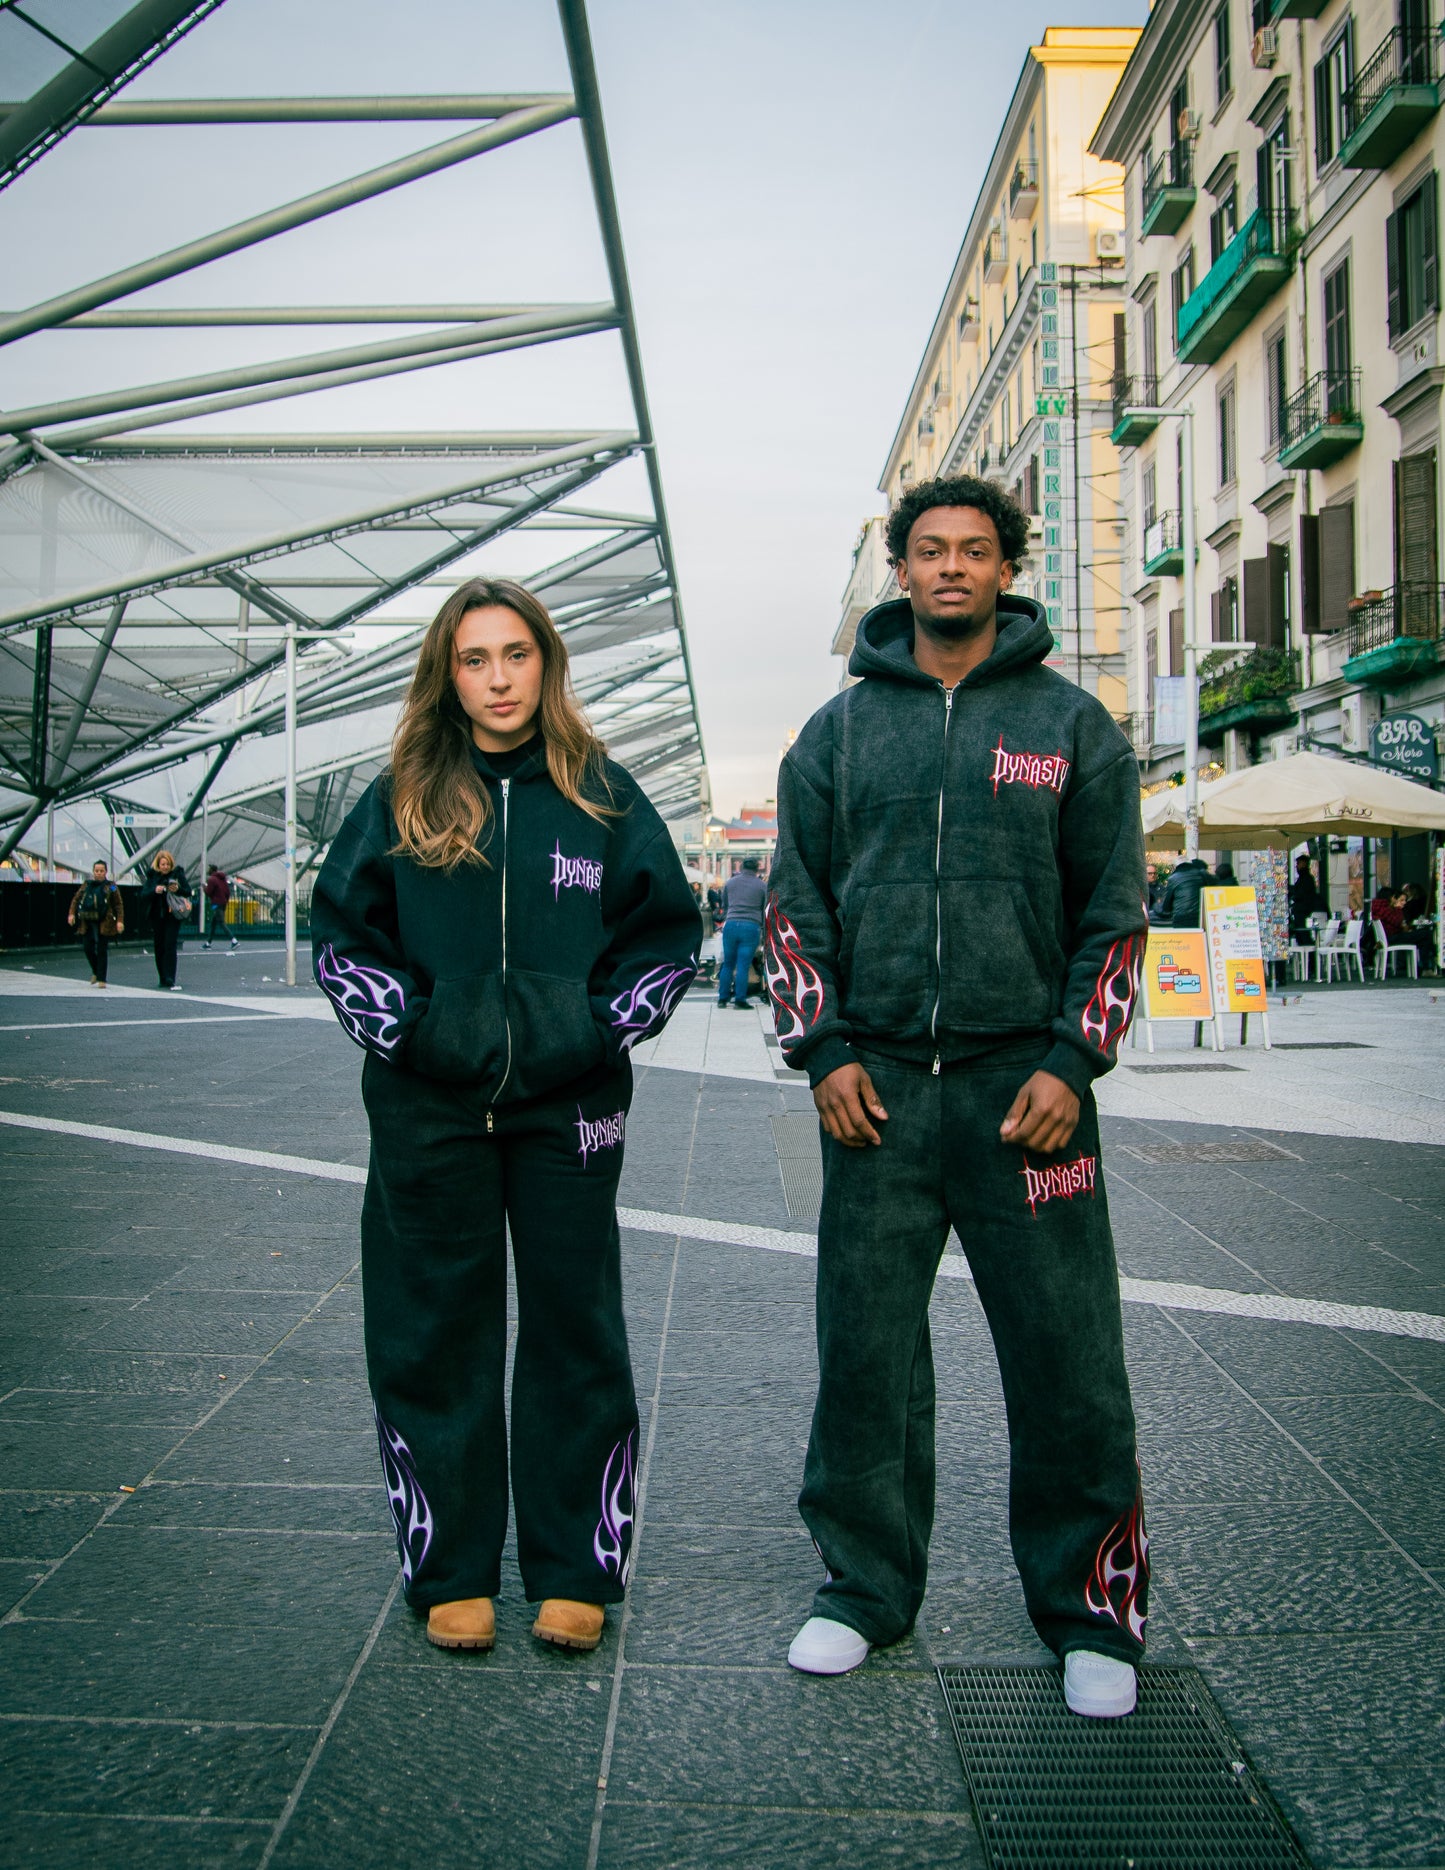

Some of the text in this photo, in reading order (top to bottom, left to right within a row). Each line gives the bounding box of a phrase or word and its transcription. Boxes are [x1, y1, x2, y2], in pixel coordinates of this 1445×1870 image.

[1041, 263, 1058, 385] HOTEL
[1036, 398, 1066, 415] HV
[1044, 422, 1062, 652] VERGILIUS
[1378, 719, 1431, 745] BAR
[989, 736, 1071, 800] DYNASTY
[549, 838, 603, 902] DYNAS
[1211, 914, 1225, 1006] TABACCHI
[1018, 1153, 1096, 1217] DYNASTY
